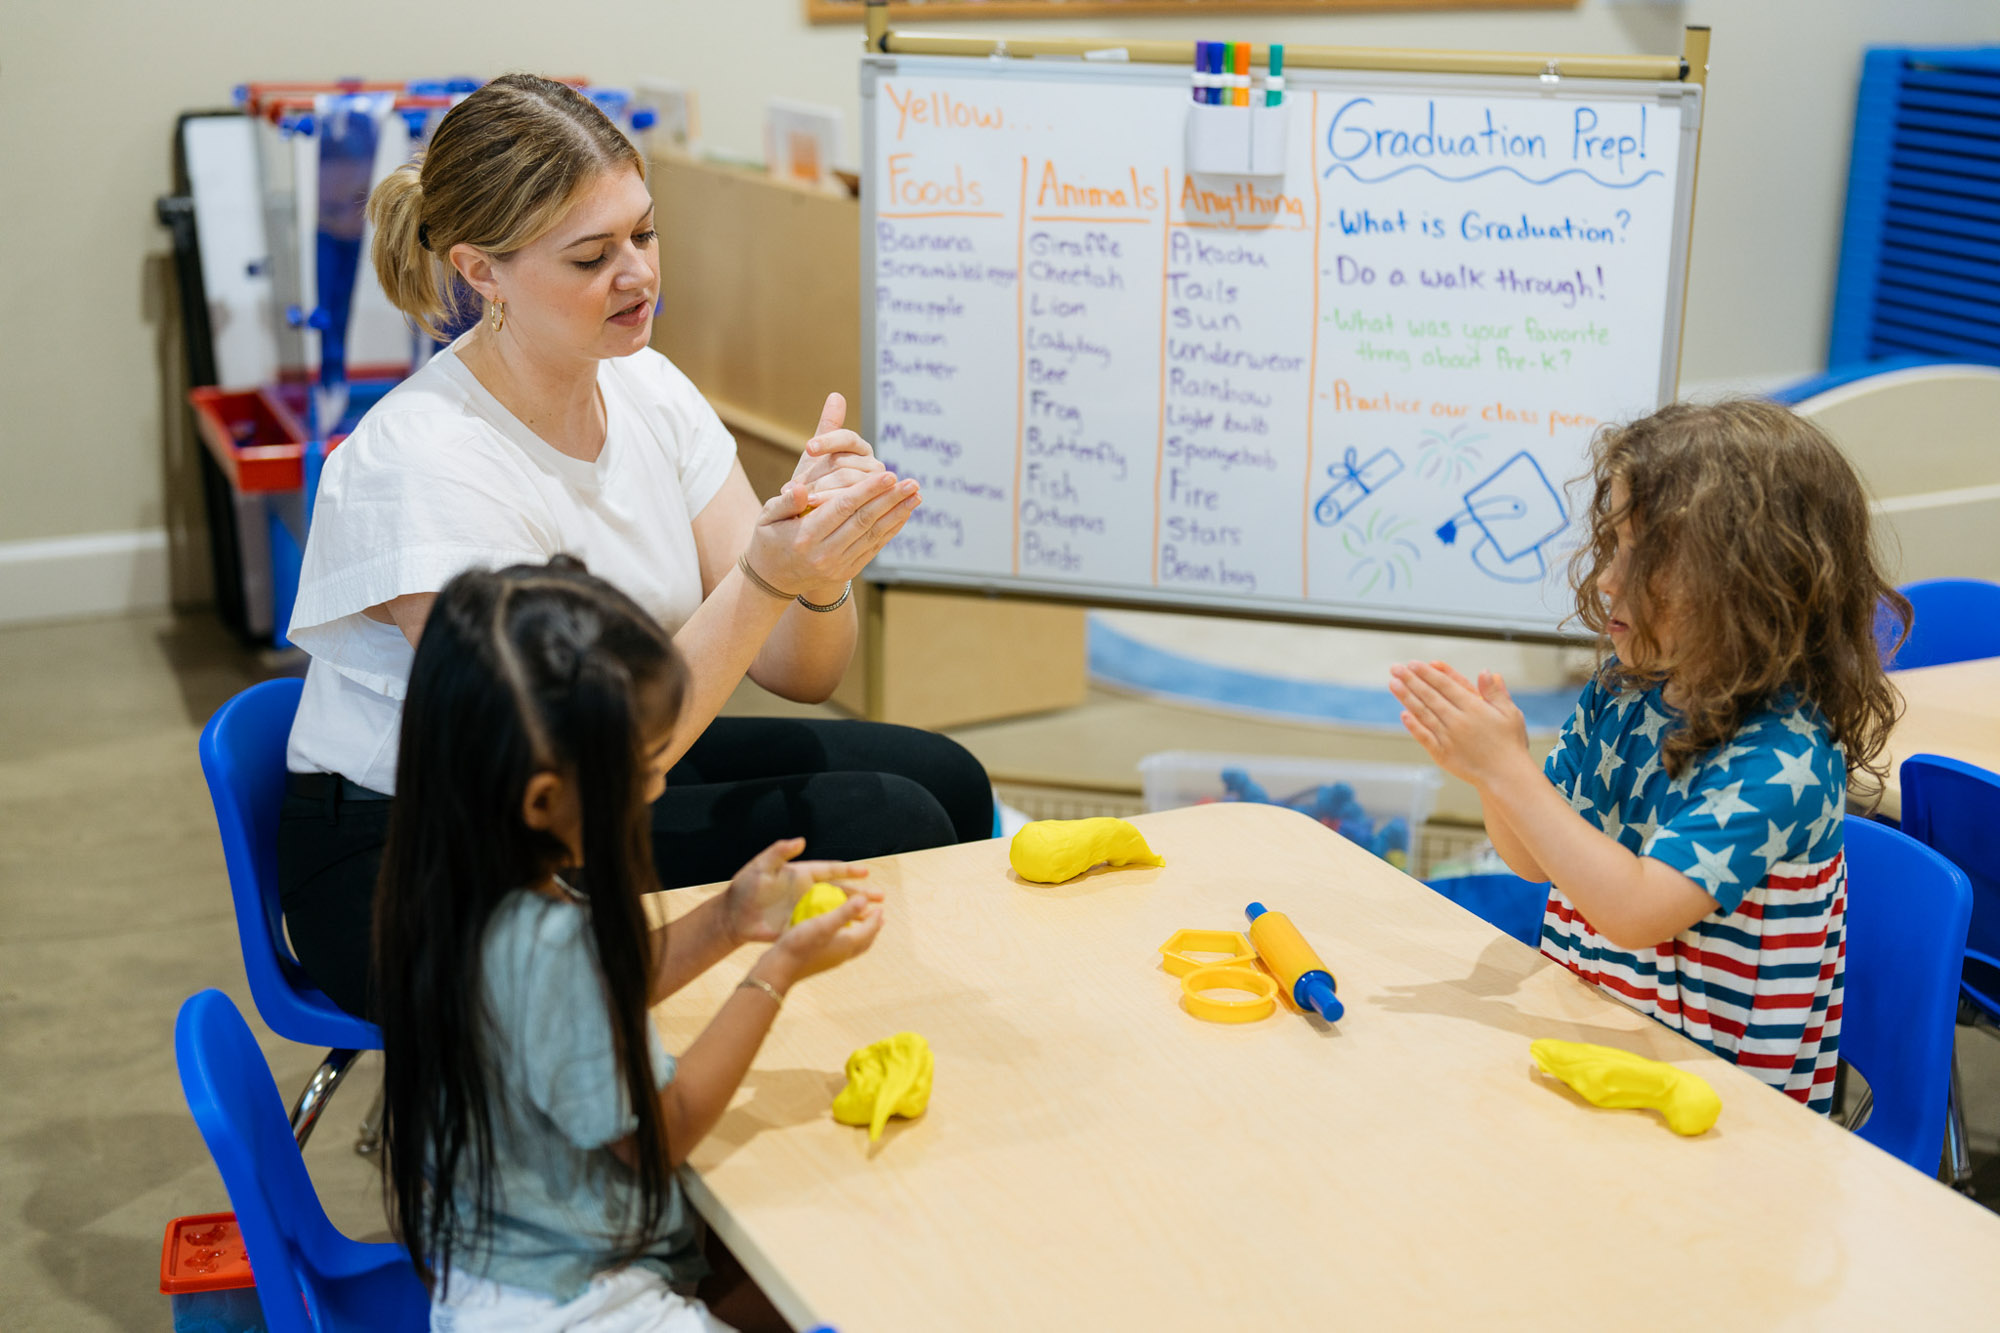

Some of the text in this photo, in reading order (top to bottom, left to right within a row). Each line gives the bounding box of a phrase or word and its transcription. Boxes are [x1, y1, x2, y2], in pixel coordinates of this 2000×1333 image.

[1327, 97, 1646, 174] Graduation Prep!
[887, 153, 985, 206] Foods
[1036, 159, 1160, 211] Animals
[1179, 173, 1306, 230] Anything
[877, 220, 975, 253] Banana
[1029, 231, 1123, 257] Giraffe
[1421, 210, 1446, 238] is
[1461, 209, 1632, 245] Graduation?
[1171, 230, 1270, 269] Pikachu
[1028, 259, 1125, 291] Cheetah
[1166, 272, 1238, 305] Tails
[1388, 269, 1406, 287] a
[1420, 263, 1486, 291] walk
[1494, 264, 1606, 309] through!
[1030, 293, 1086, 318] Lion
[1172, 306, 1241, 331] Sun
[1407, 319, 1452, 338] was
[1462, 323, 1512, 354] your
[1028, 358, 1068, 385] Bee
[1355, 341, 1412, 372] thing
[1421, 345, 1482, 369] about
[1169, 366, 1272, 408] Rainbow
[1030, 390, 1084, 436] Frog
[1430, 403, 1470, 418] our
[1481, 402, 1539, 425] class
[1027, 426, 1128, 482] Butterfly
[1026, 461, 1079, 505] Fish
[1169, 465, 1219, 512] Fire
[1020, 498, 1106, 536] Octopus
[1166, 515, 1241, 546] Stars
